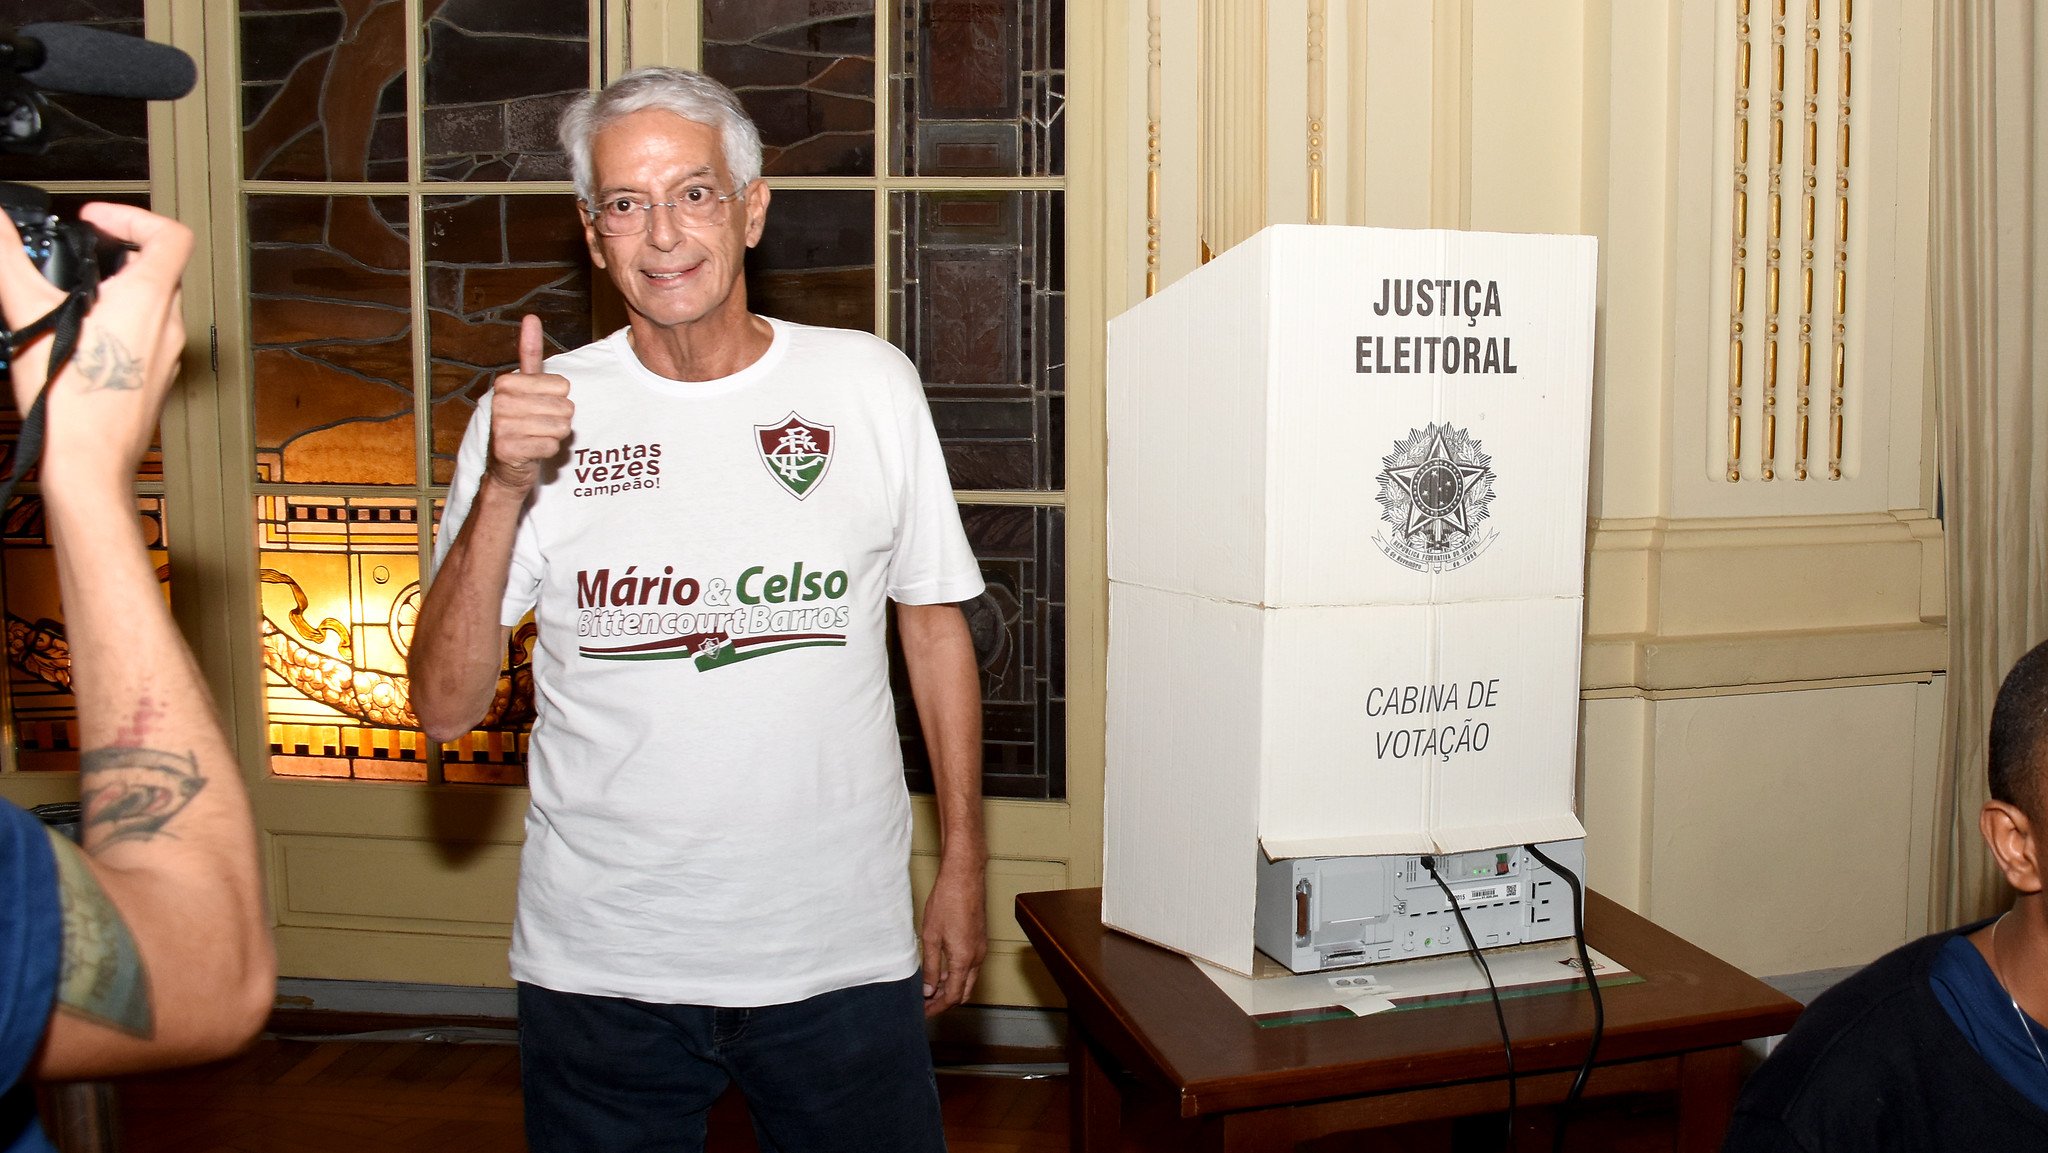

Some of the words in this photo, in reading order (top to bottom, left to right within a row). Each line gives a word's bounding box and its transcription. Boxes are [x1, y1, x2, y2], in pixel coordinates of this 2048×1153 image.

[1373, 279, 1502, 327] JUSTIÇA
[1355, 335, 1518, 375] ELEITORAL
[574, 443, 662, 466] Tantas
[574, 458, 661, 484] vezes
[573, 477, 661, 498] campeão!
[1461, 539, 1478, 554] BRASIL
[577, 566, 700, 609] Mário
[703, 577, 731, 607] &
[736, 561, 849, 605] Celso
[577, 608, 745, 638] Bittencourt
[748, 604, 850, 634] Barros
[1366, 683, 1458, 717] CABINA
[1467, 678, 1500, 709] DE
[1376, 718, 1490, 762] VOTAÇÃO
